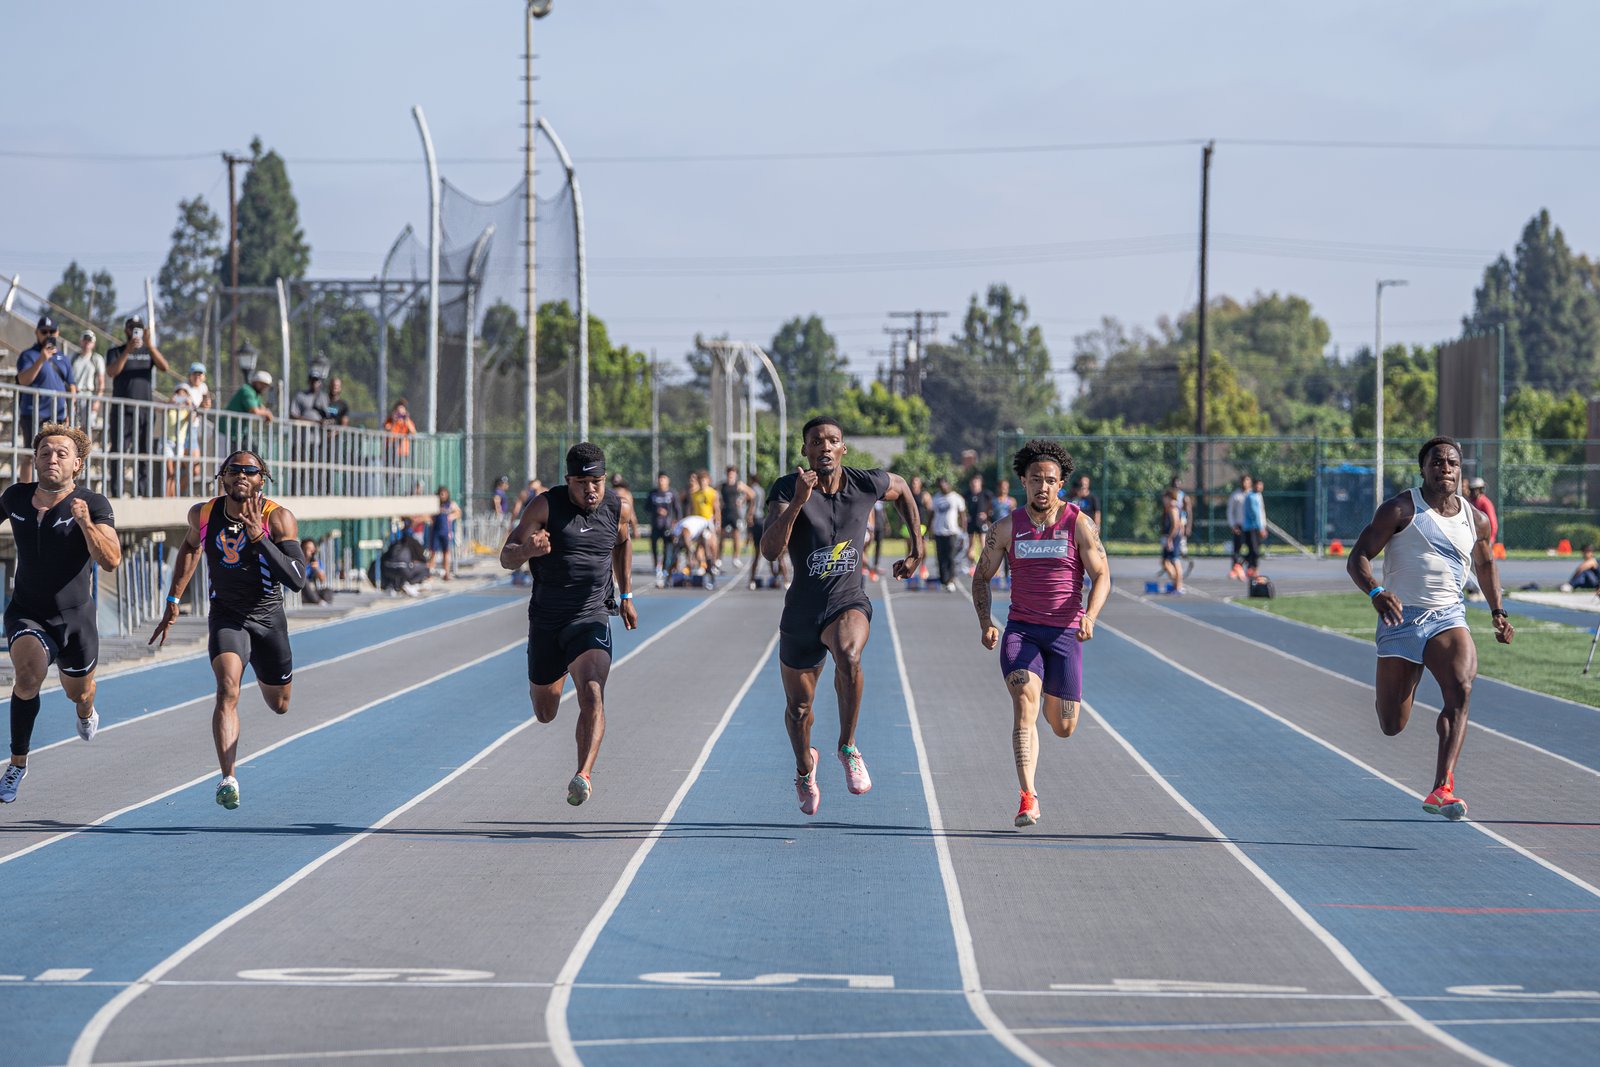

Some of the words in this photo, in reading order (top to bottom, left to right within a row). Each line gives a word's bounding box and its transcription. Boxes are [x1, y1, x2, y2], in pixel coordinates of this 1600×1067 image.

[1018, 542, 1067, 558] SHARKS
[808, 559, 855, 576] MORE
[639, 972, 895, 988] 5
[1050, 979, 1308, 992] 4
